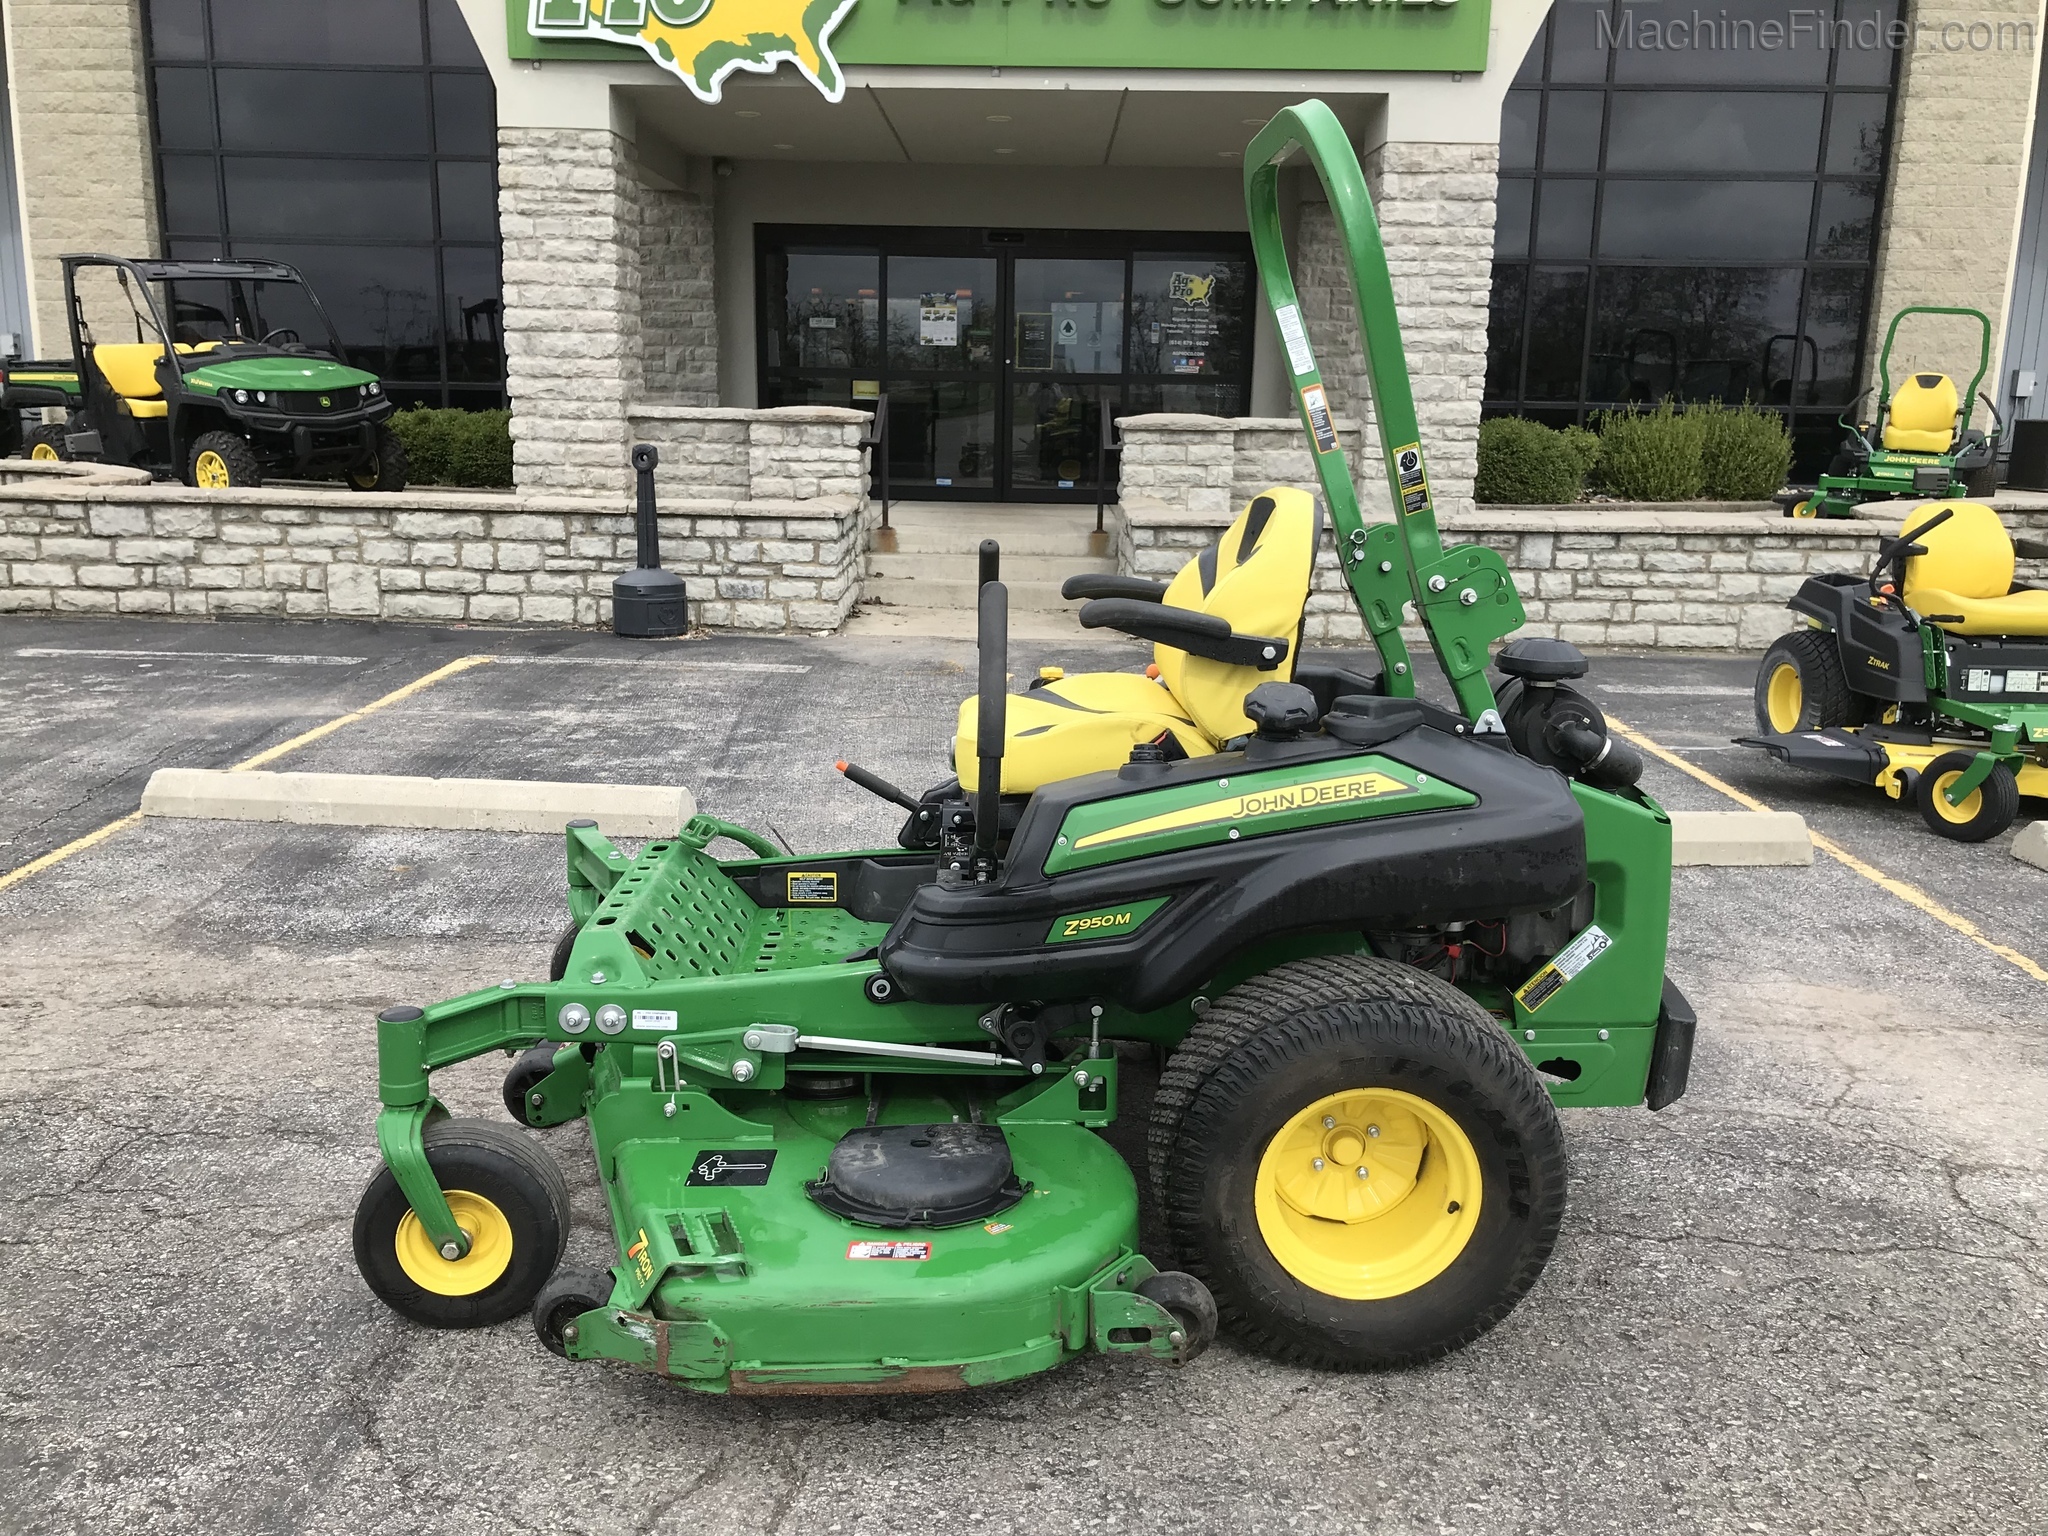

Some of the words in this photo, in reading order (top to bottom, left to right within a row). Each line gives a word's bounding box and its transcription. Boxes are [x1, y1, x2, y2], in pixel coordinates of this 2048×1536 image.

[1172, 274, 1194, 287] Ag-
[1172, 286, 1193, 296] Pro
[1884, 455, 1908, 463] JOHN
[1909, 456, 1941, 465] DEERE
[1867, 655, 1890, 670] ZTRAK
[1233, 793, 1294, 816] JOHN
[1301, 779, 1377, 804] DEERE
[1063, 912, 1132, 936] Z950M
